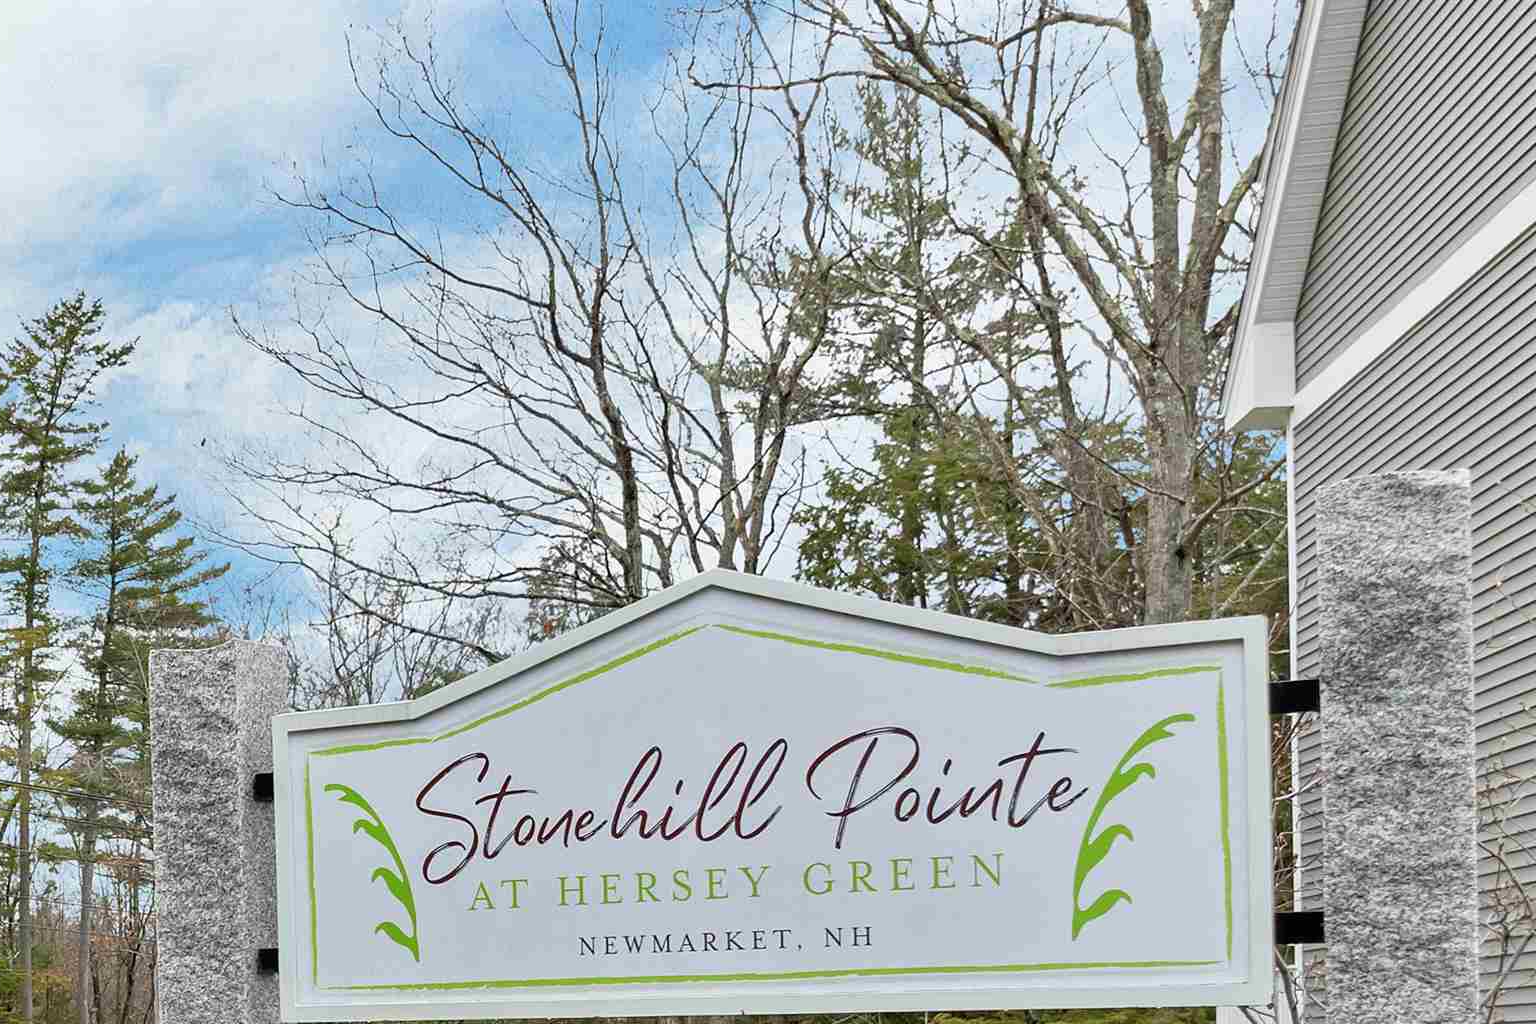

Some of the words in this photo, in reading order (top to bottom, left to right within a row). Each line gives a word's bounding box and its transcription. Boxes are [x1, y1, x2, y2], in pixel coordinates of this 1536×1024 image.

[416, 738, 788, 884] Stonehill
[806, 726, 1088, 849] Pointe
[467, 878, 529, 911] AT
[556, 864, 771, 907] HERSEY
[802, 852, 1004, 896] GREEN
[577, 928, 803, 957] NEWMARKET,
[823, 926, 873, 948] NH
